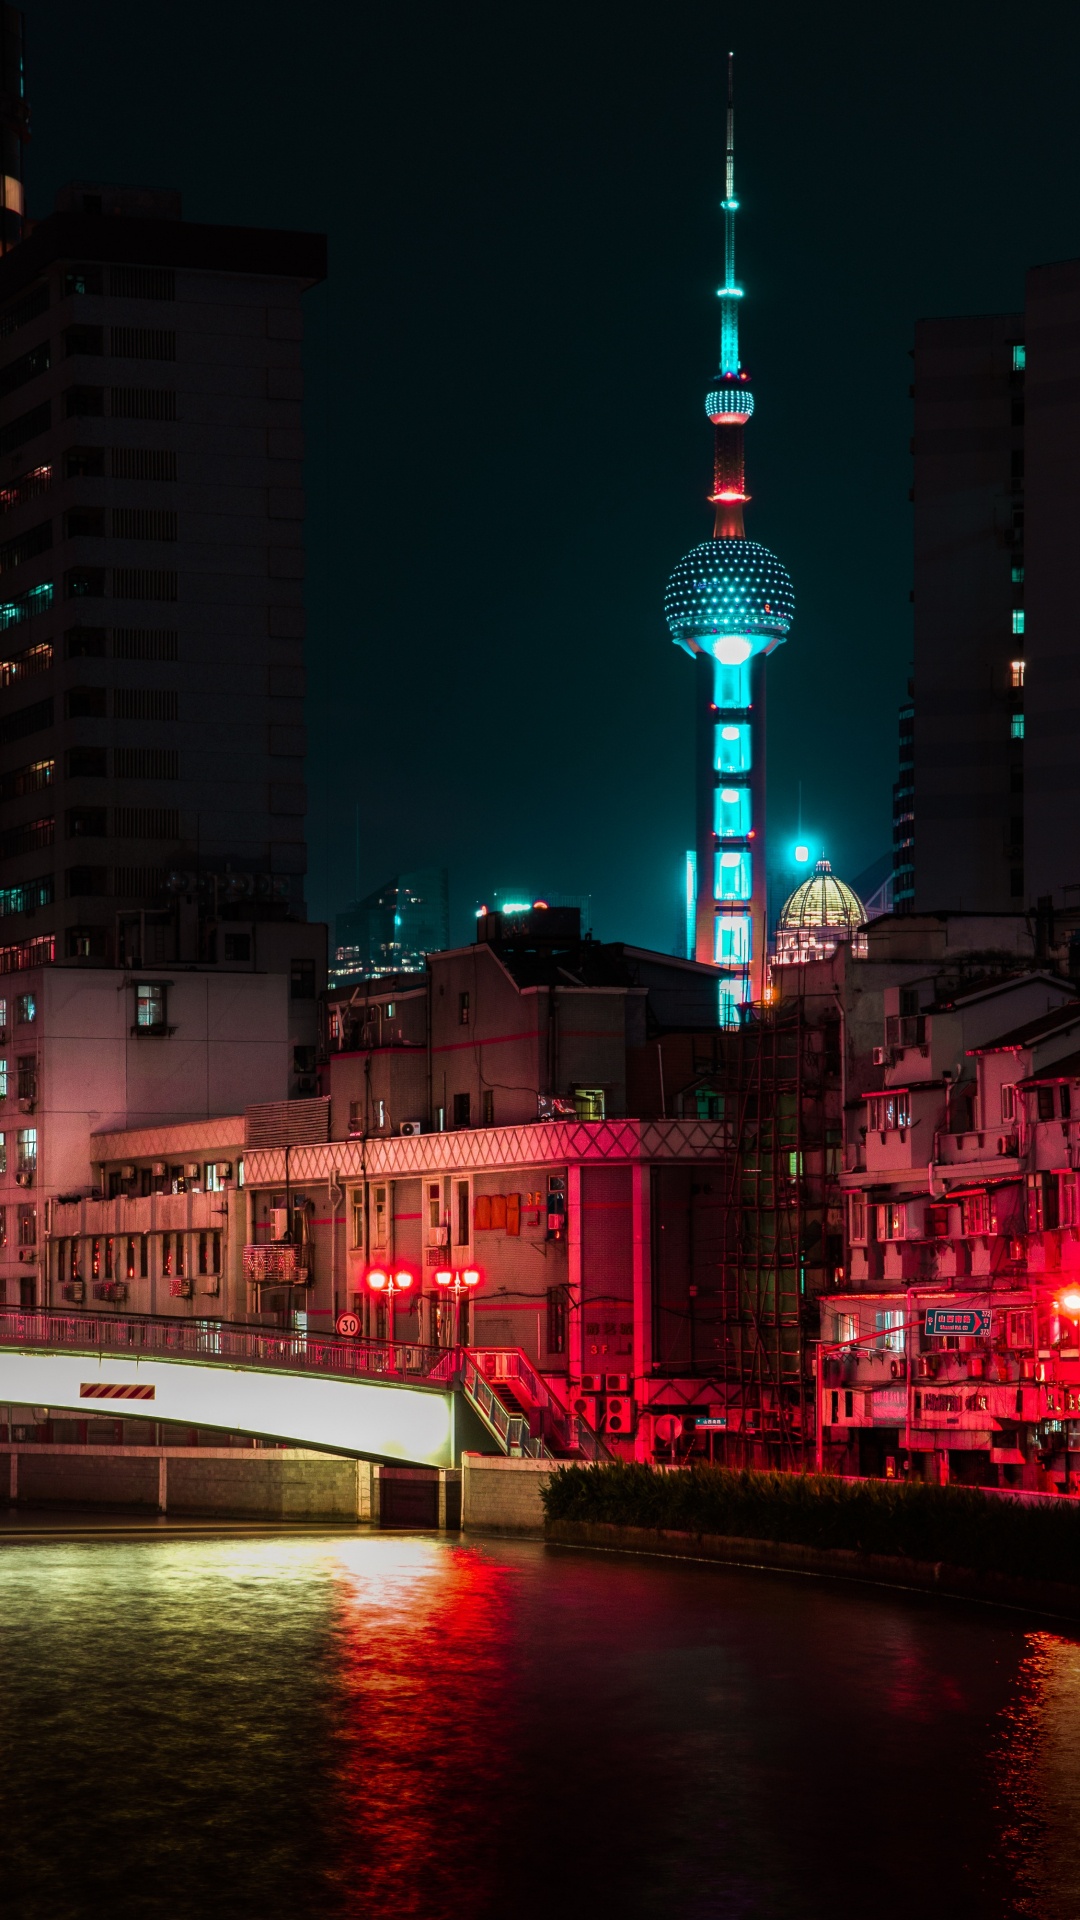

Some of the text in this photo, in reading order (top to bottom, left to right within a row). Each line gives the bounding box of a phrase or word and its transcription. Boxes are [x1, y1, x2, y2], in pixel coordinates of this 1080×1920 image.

[938, 1315, 971, 1323] 山西南路
[342, 1320, 355, 1332] 30
